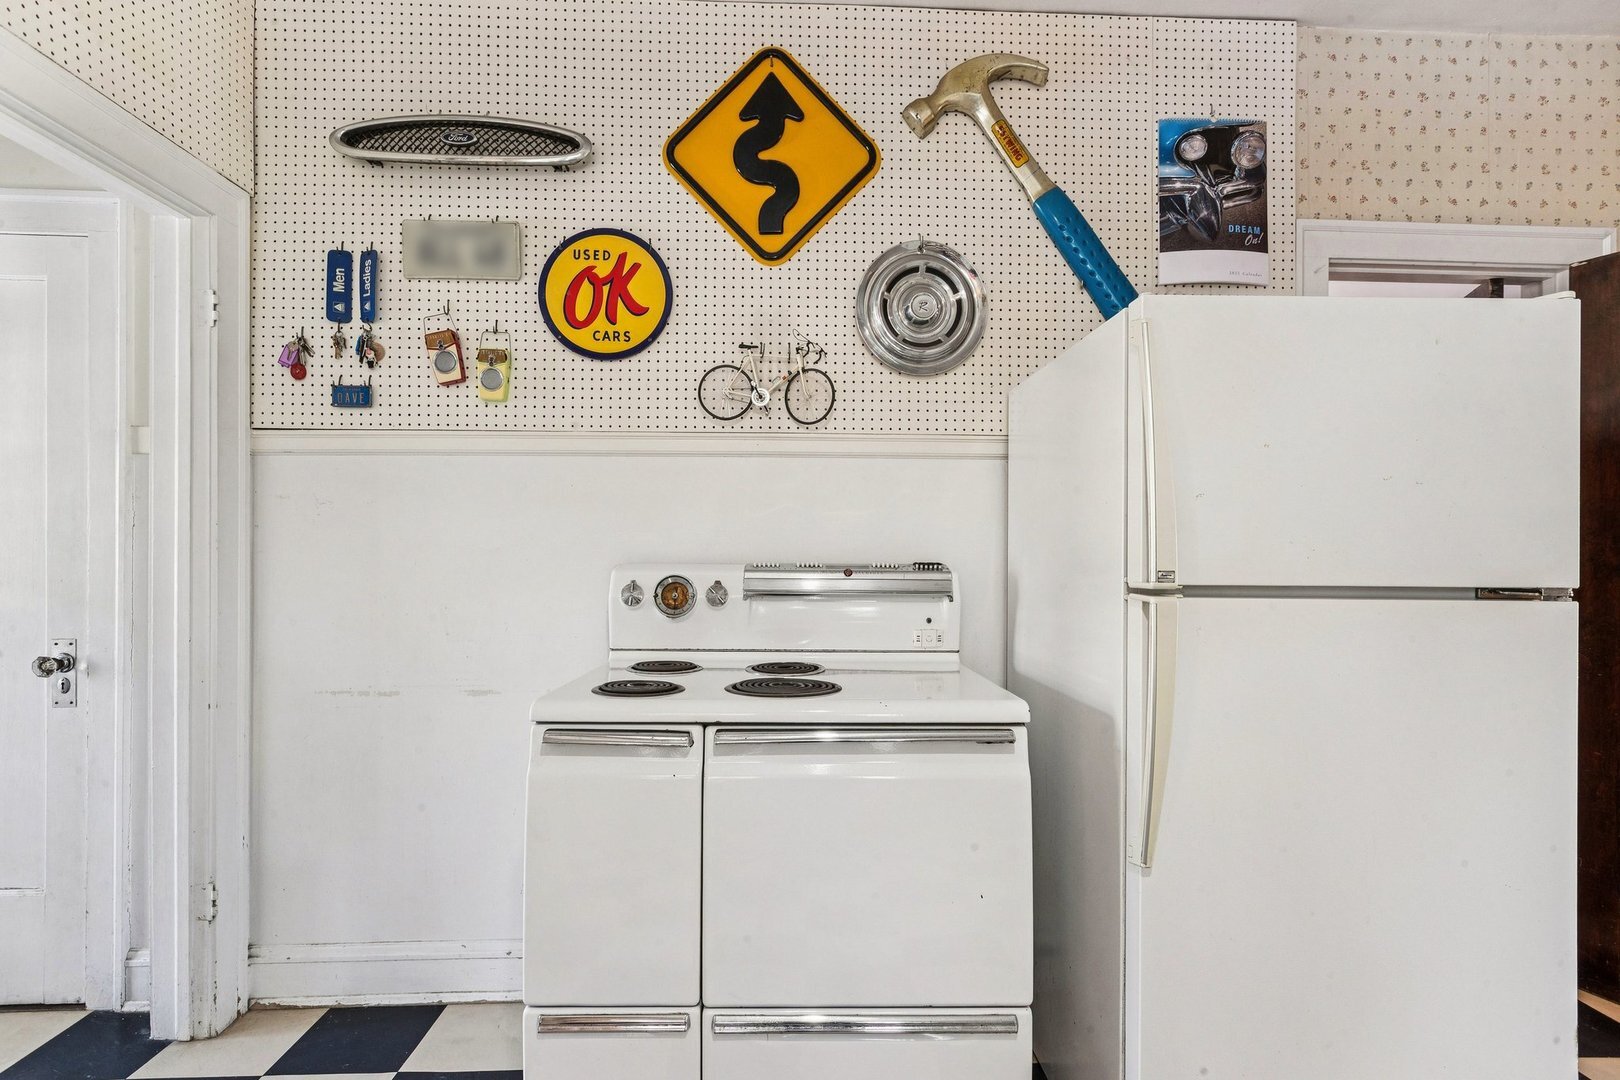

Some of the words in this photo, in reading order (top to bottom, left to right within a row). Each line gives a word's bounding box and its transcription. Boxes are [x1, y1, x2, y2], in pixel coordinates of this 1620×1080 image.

[448, 133, 469, 142] Ford
[1228, 224, 1261, 235] DREAM
[1245, 232, 1264, 246] On!
[573, 249, 611, 260] USED
[332, 268, 345, 293] Men
[362, 259, 372, 297] Ladies
[563, 252, 650, 330] OK
[592, 330, 631, 342] CARS
[337, 392, 365, 404] DAVE
